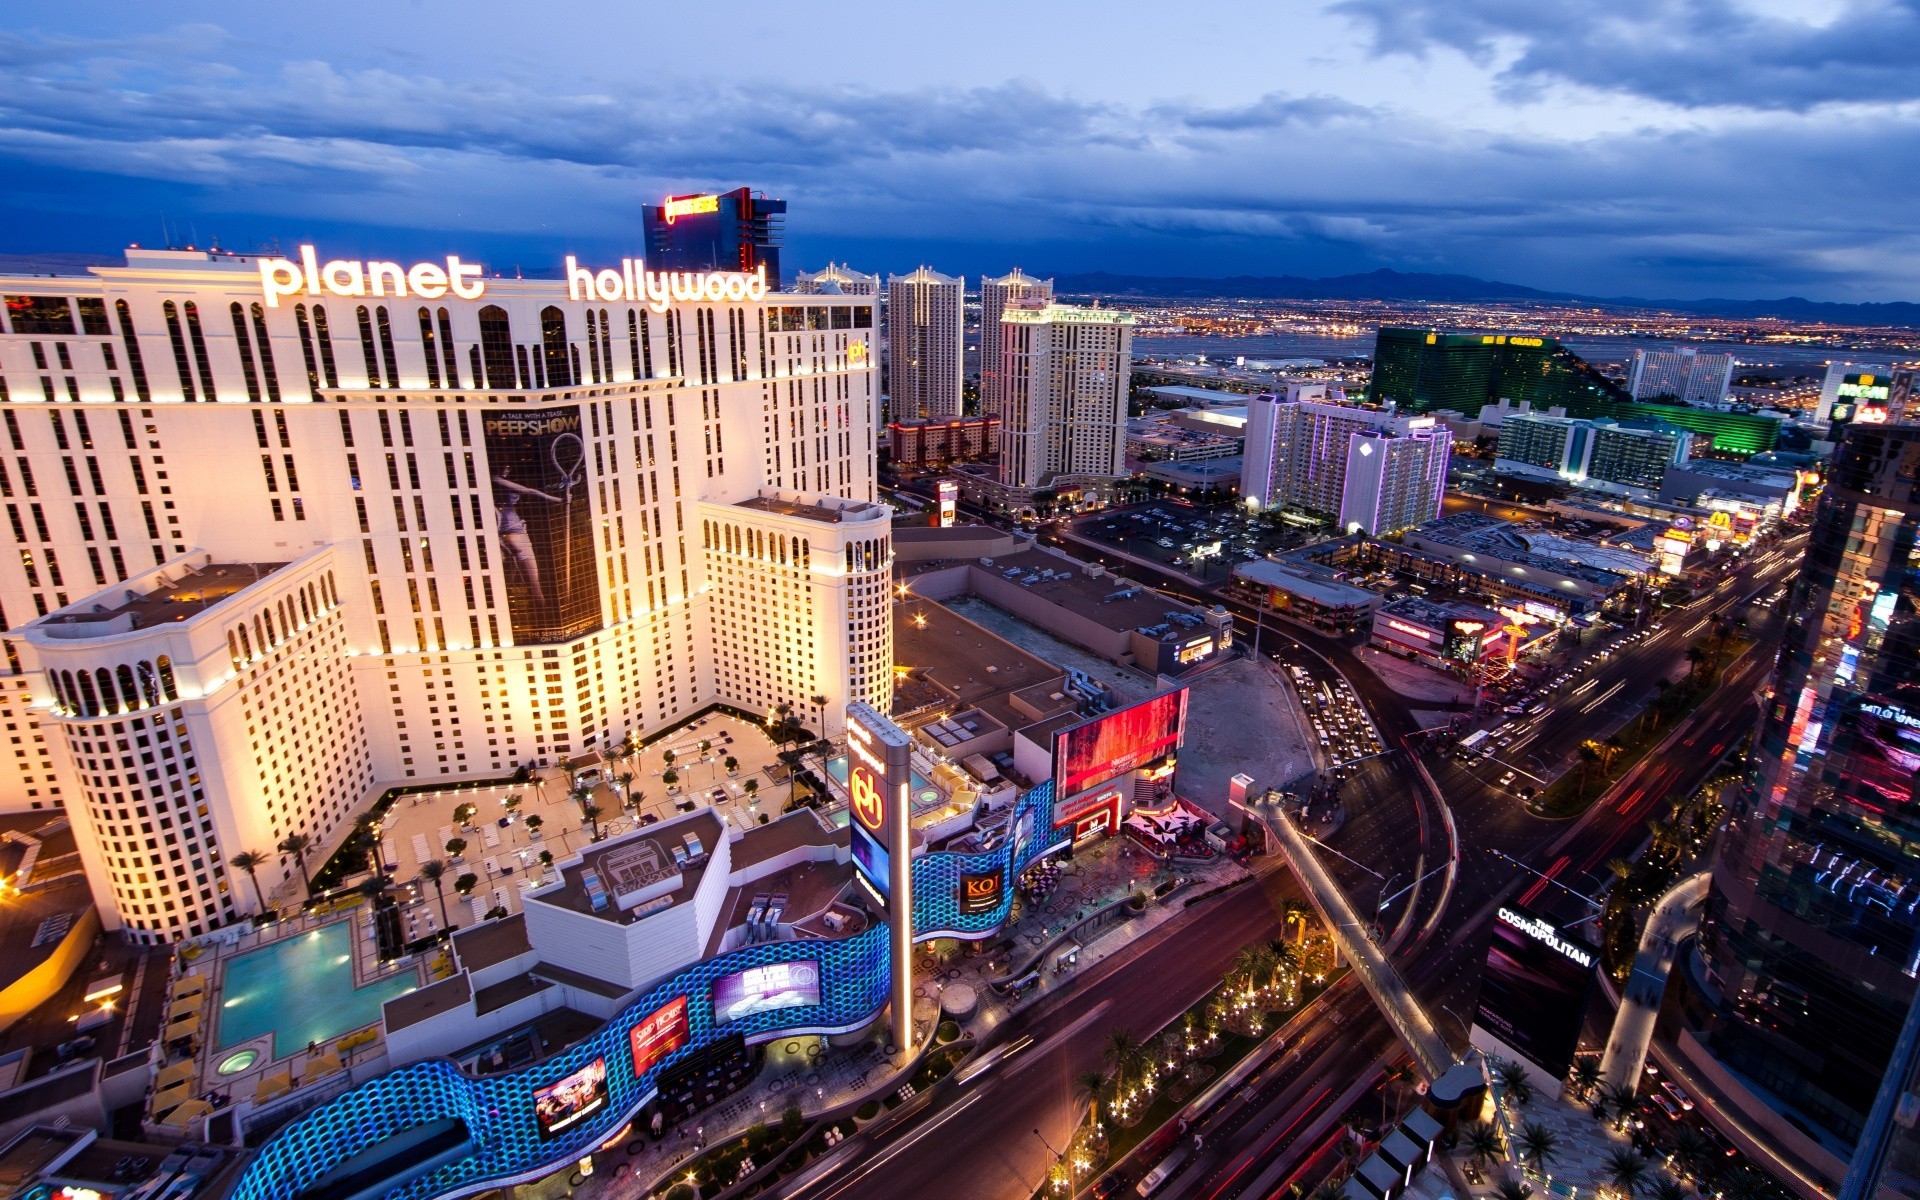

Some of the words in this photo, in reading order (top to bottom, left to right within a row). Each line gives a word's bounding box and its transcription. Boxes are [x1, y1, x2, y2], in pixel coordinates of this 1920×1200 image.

[257, 244, 485, 308] planet
[565, 256, 766, 313] hollywood
[1510, 337, 1543, 347] GRAND
[1837, 383, 1889, 400] MGM
[486, 415, 580, 436] PEEPSHOW
[853, 769, 883, 824] ph
[967, 874, 999, 894] KOI
[1498, 907, 1591, 967] COSMOPOLITAN
[1535, 918, 1555, 936] THE
